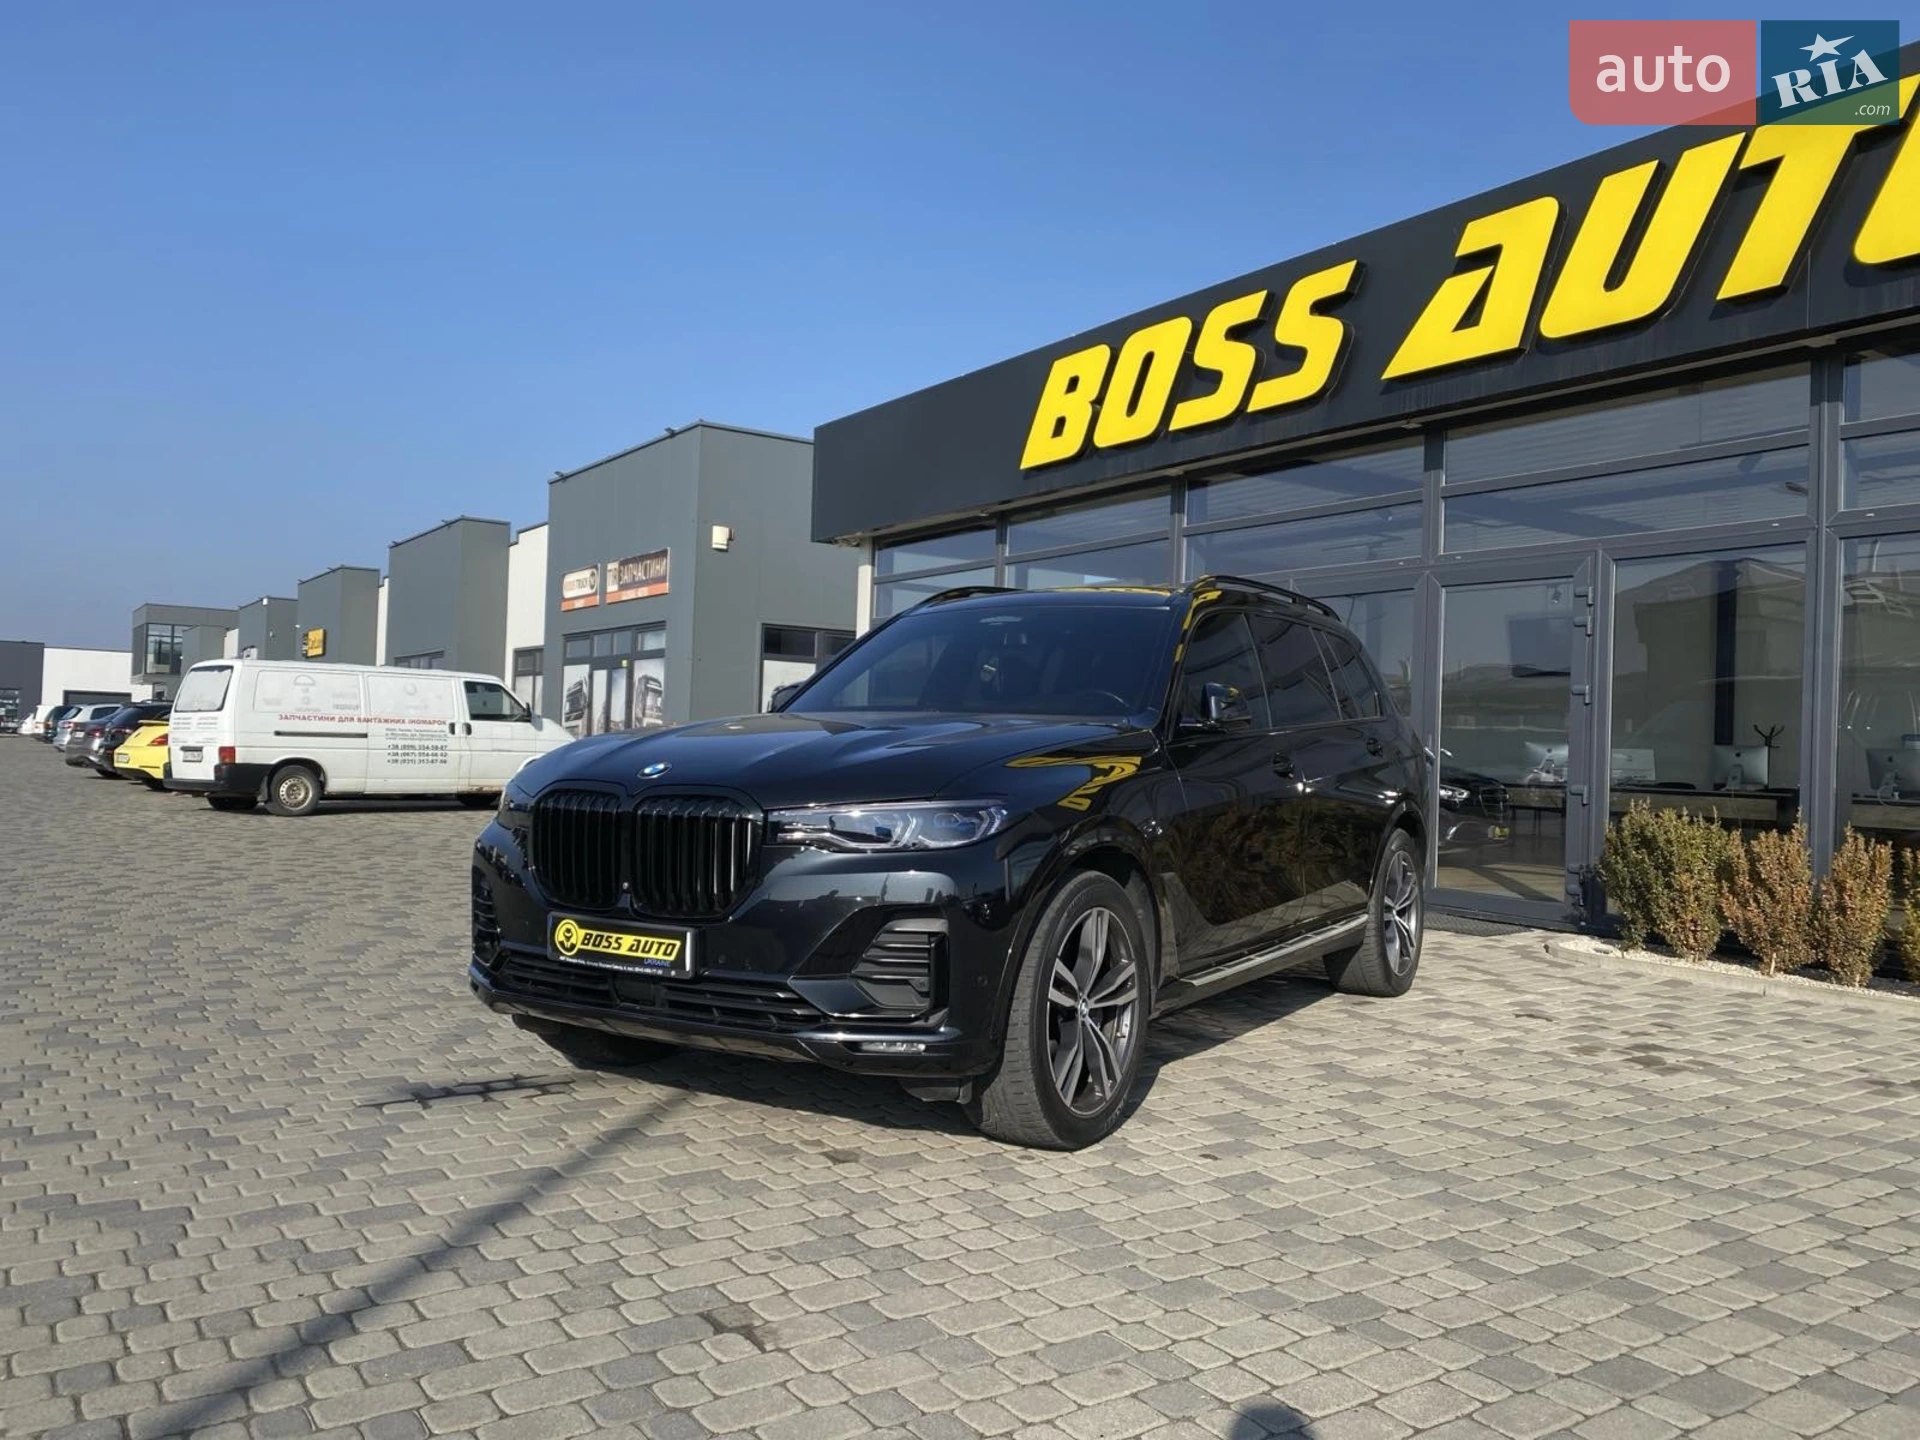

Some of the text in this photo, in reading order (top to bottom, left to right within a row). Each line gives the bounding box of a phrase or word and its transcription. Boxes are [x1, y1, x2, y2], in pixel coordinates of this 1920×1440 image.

[1020, 260, 1358, 470] BOSS
[619, 556, 667, 585] ЗАПЧАСТИНИ
[278, 713, 336, 722] ЗАПЧАСТИНИ
[357, 717, 406, 725] ВАНТАЖНИХ
[581, 932, 678, 957] BOSS AUTO
[643, 958, 672, 967] UKRAINE
